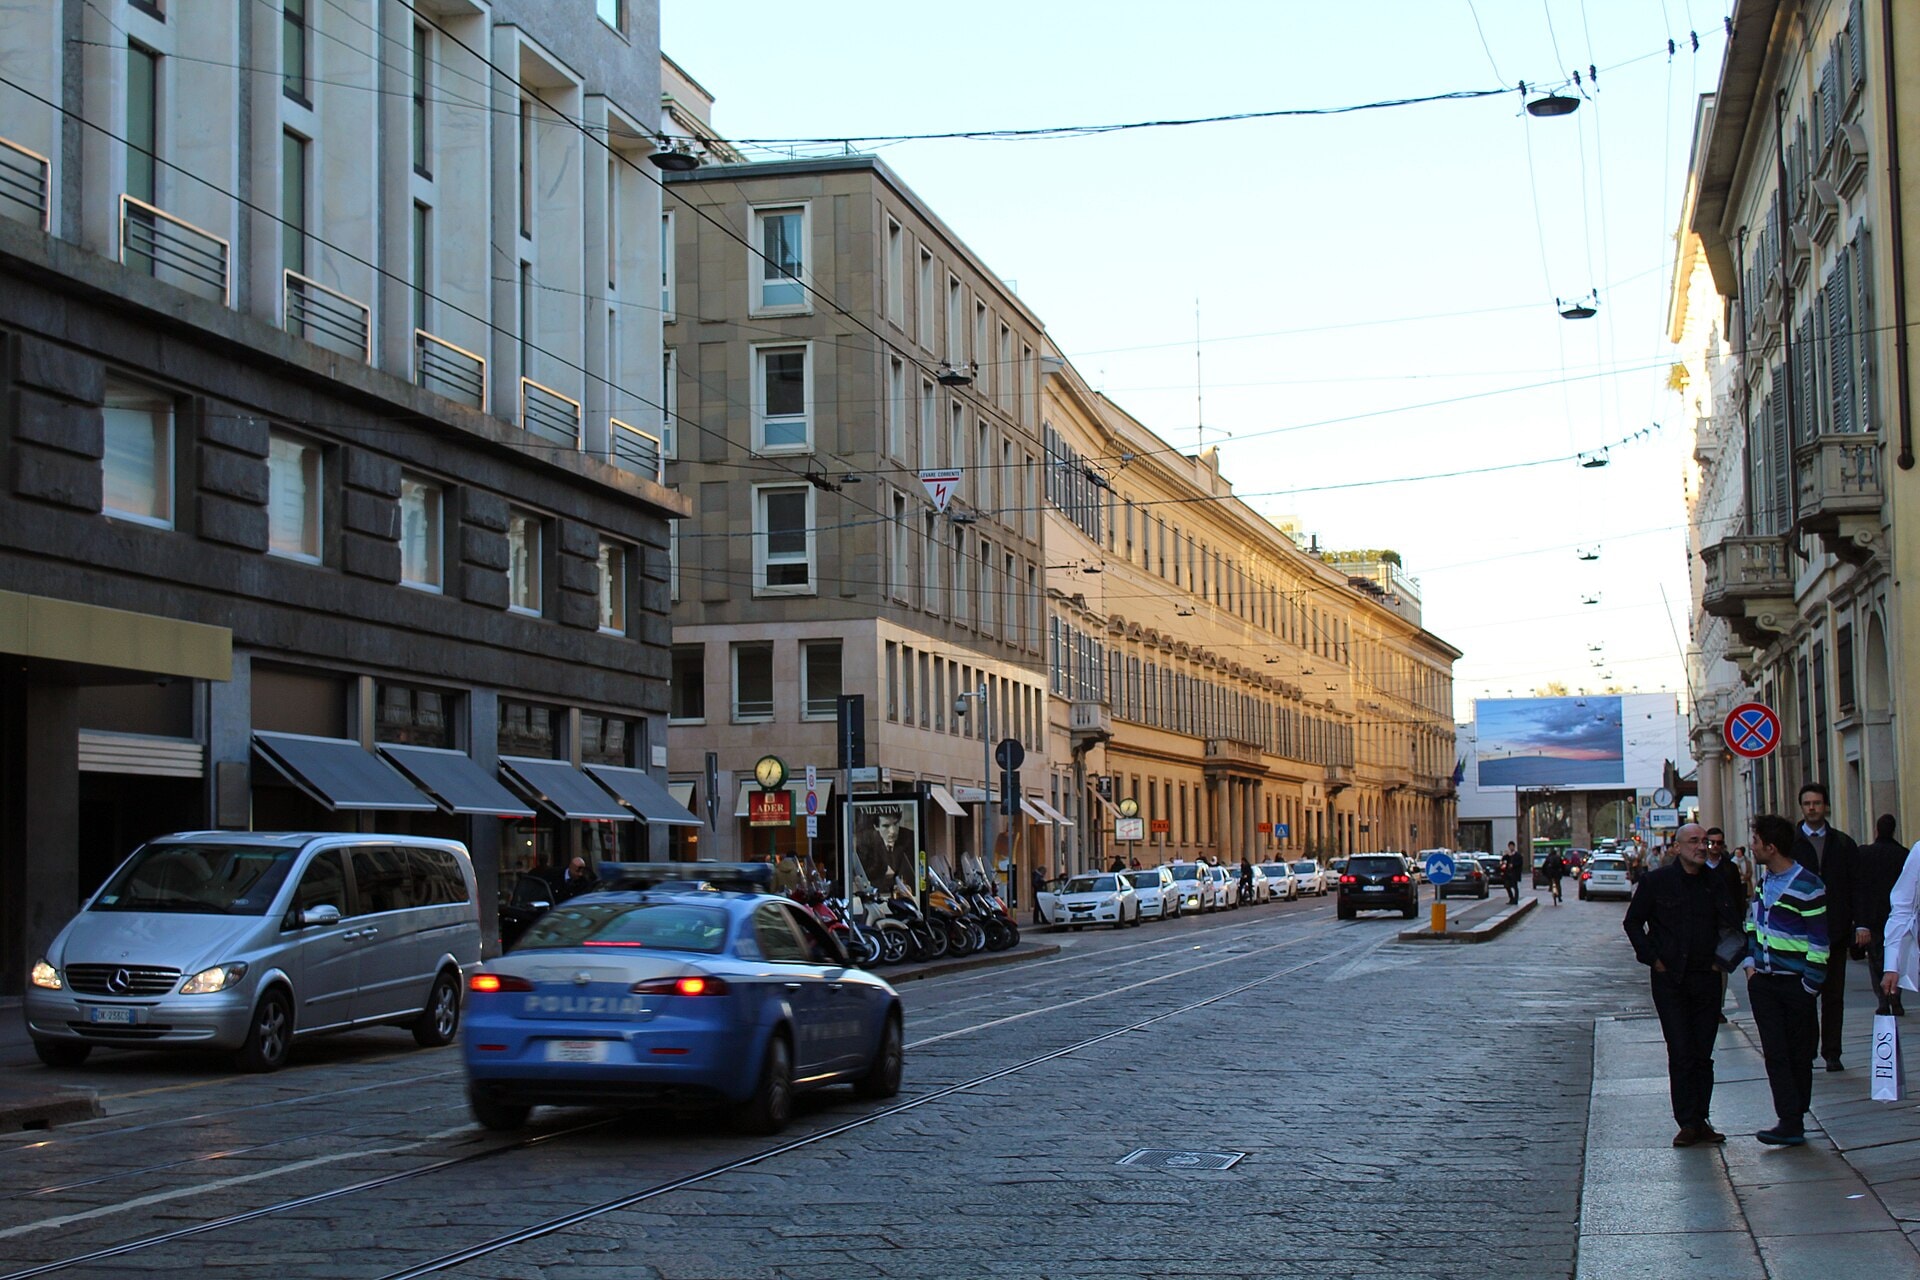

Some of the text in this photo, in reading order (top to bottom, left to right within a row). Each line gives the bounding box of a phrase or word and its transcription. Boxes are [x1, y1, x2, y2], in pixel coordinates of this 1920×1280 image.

[756, 803, 784, 812] ADER
[525, 995, 643, 1014] POLIZIA
[1875, 1032, 1893, 1079] FLOS
